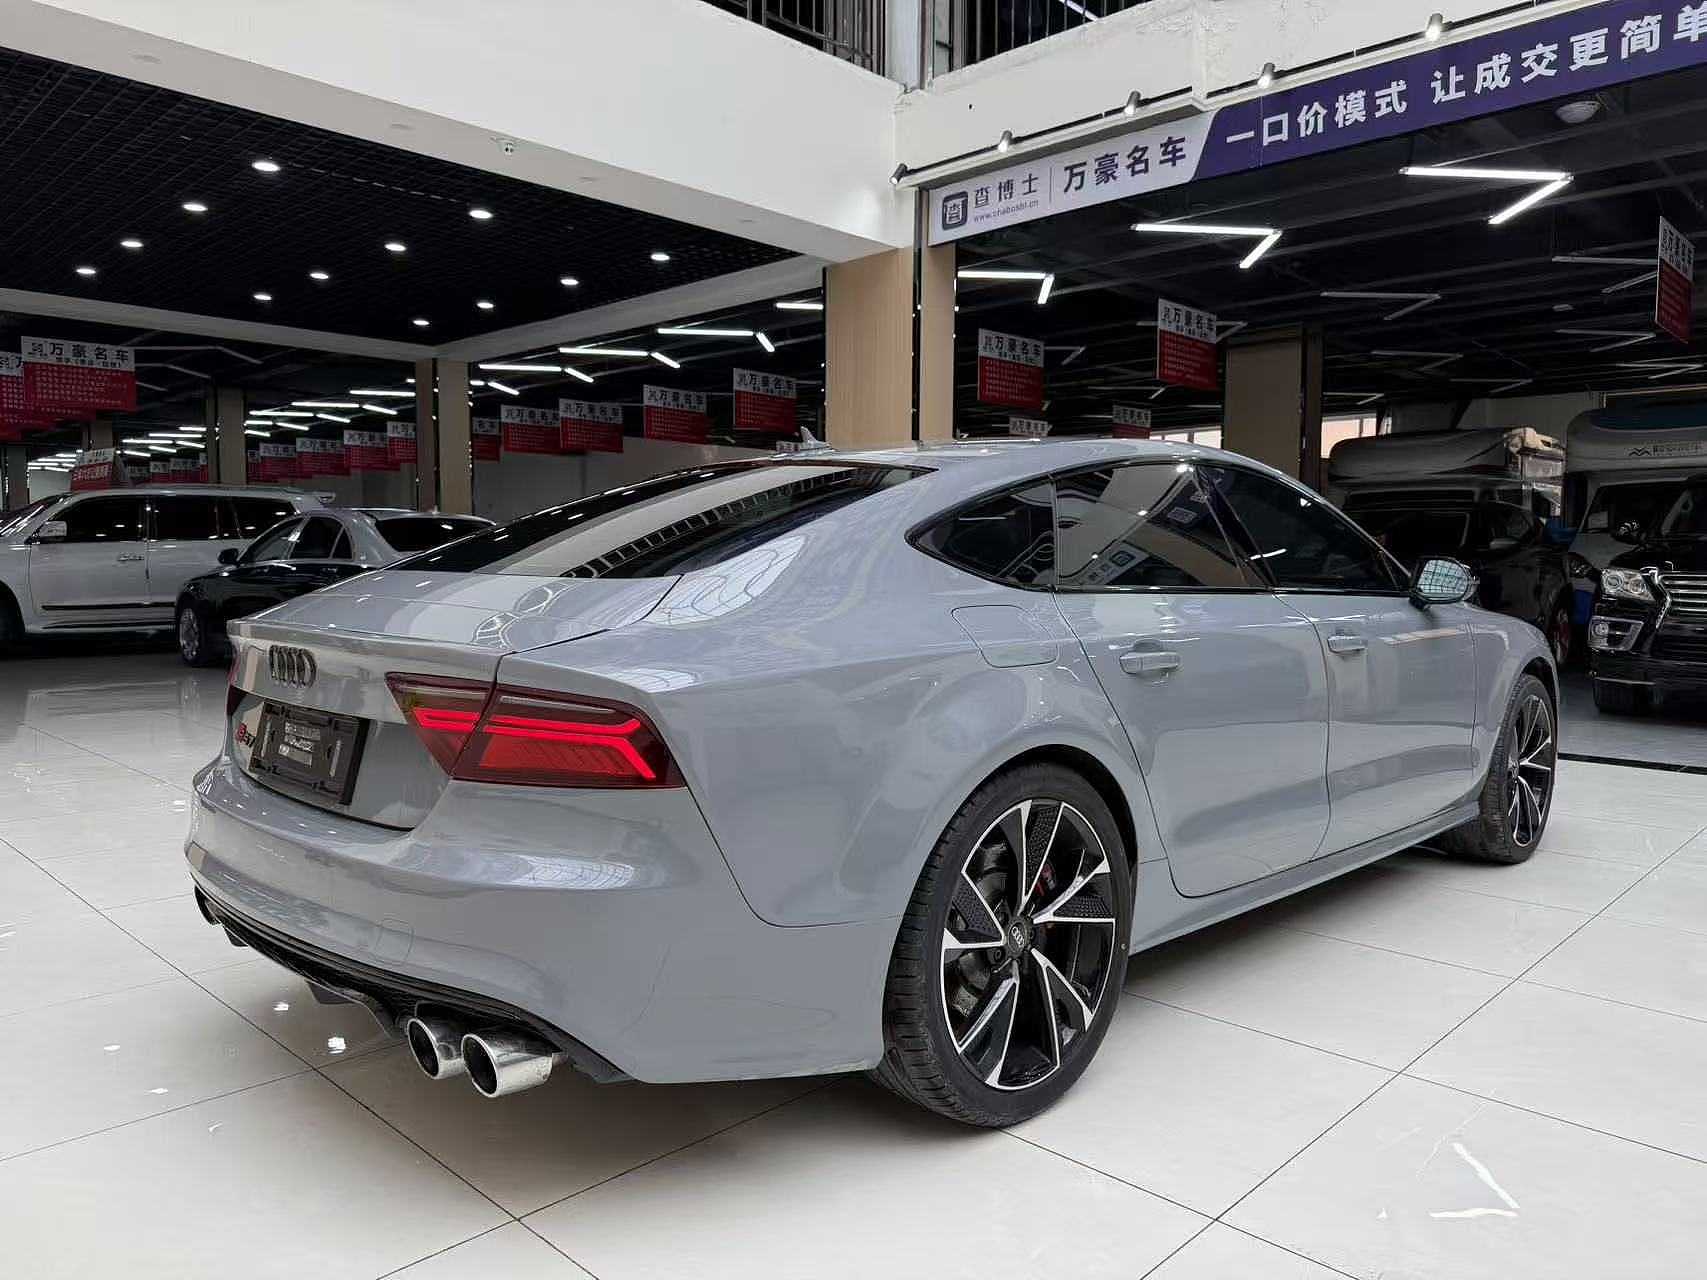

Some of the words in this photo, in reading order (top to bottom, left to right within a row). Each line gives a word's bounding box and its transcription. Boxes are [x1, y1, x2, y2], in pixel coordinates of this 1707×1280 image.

[1430, 5, 1707, 104] 让成交更简单
[1226, 80, 1408, 147] 一口价模式
[973, 173, 1040, 209] 查博士
[1063, 136, 1187, 193] 万豪名车
[51, 342, 129, 361] 万豪名车
